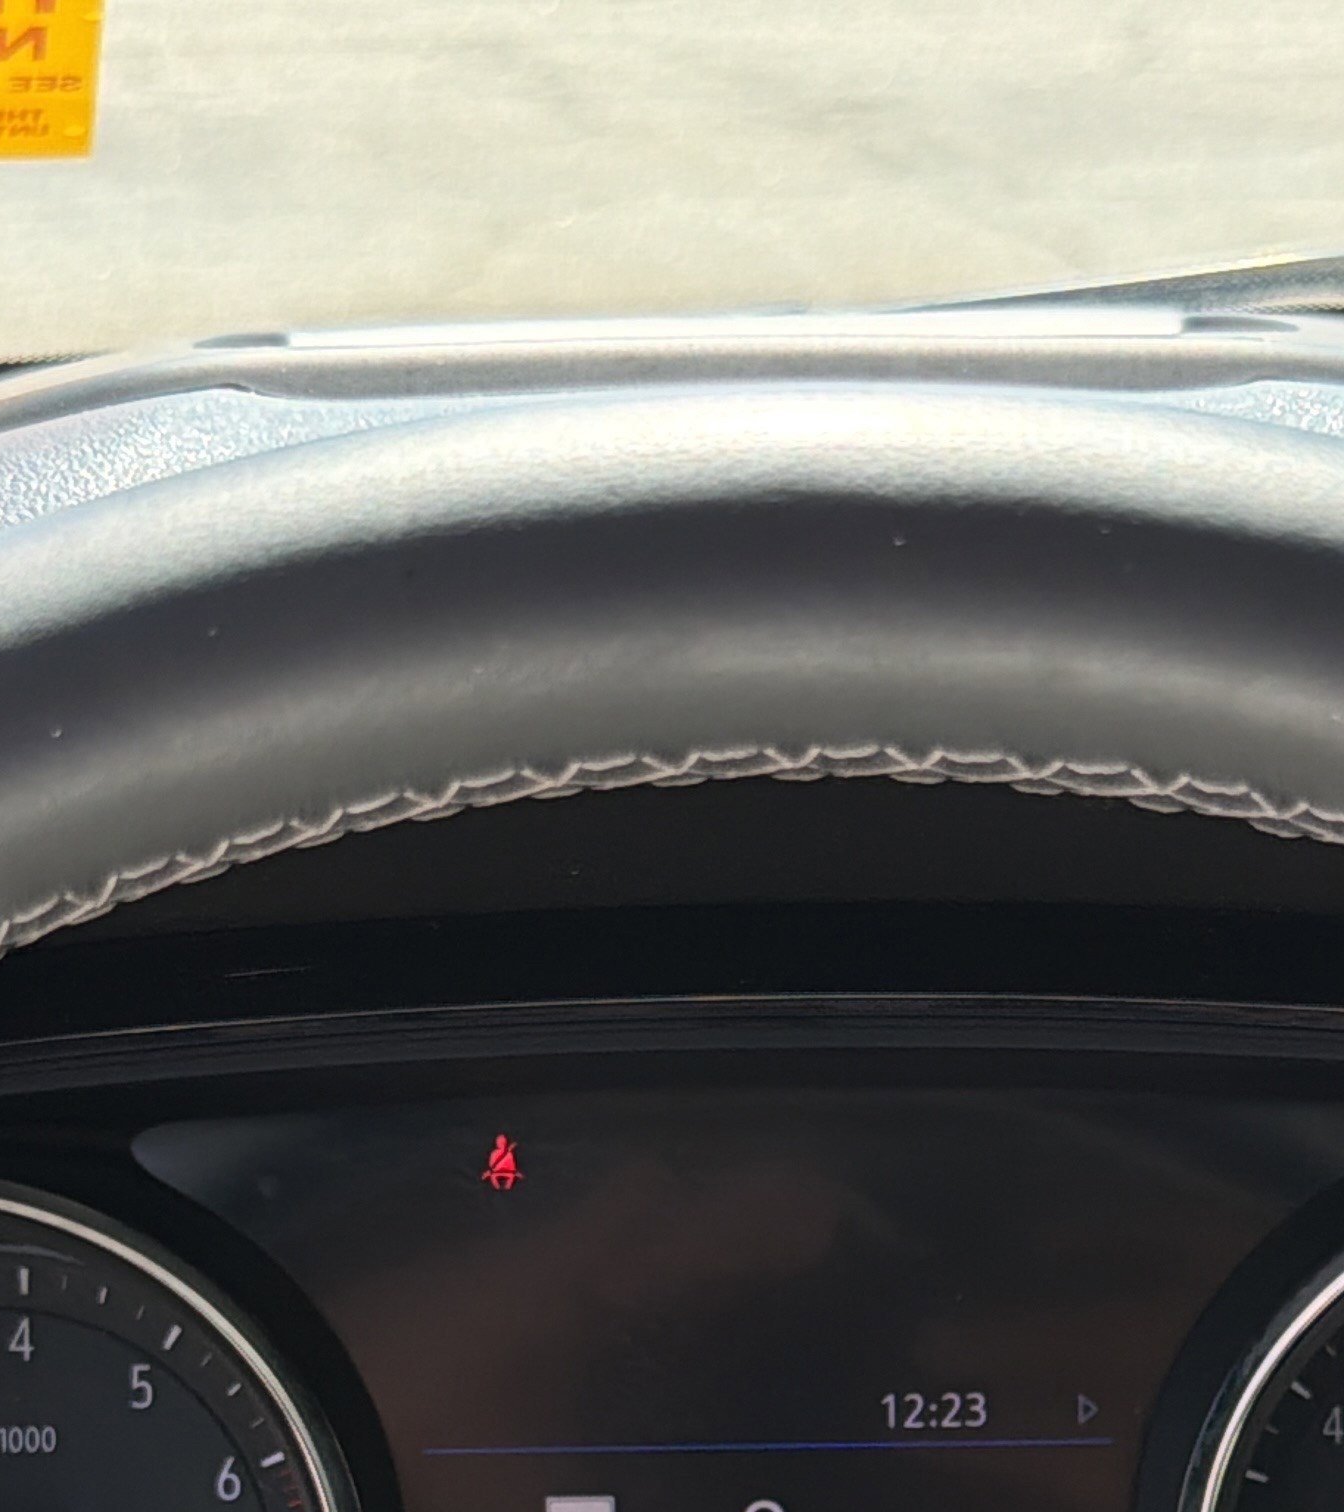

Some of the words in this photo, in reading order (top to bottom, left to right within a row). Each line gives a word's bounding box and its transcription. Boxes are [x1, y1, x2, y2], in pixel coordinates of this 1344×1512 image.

[8, 1317, 35, 1361] 4
[130, 1364, 154, 1409] 5
[880, 1392, 988, 1429] 12:23
[216, 1457, 242, 1501] 6
